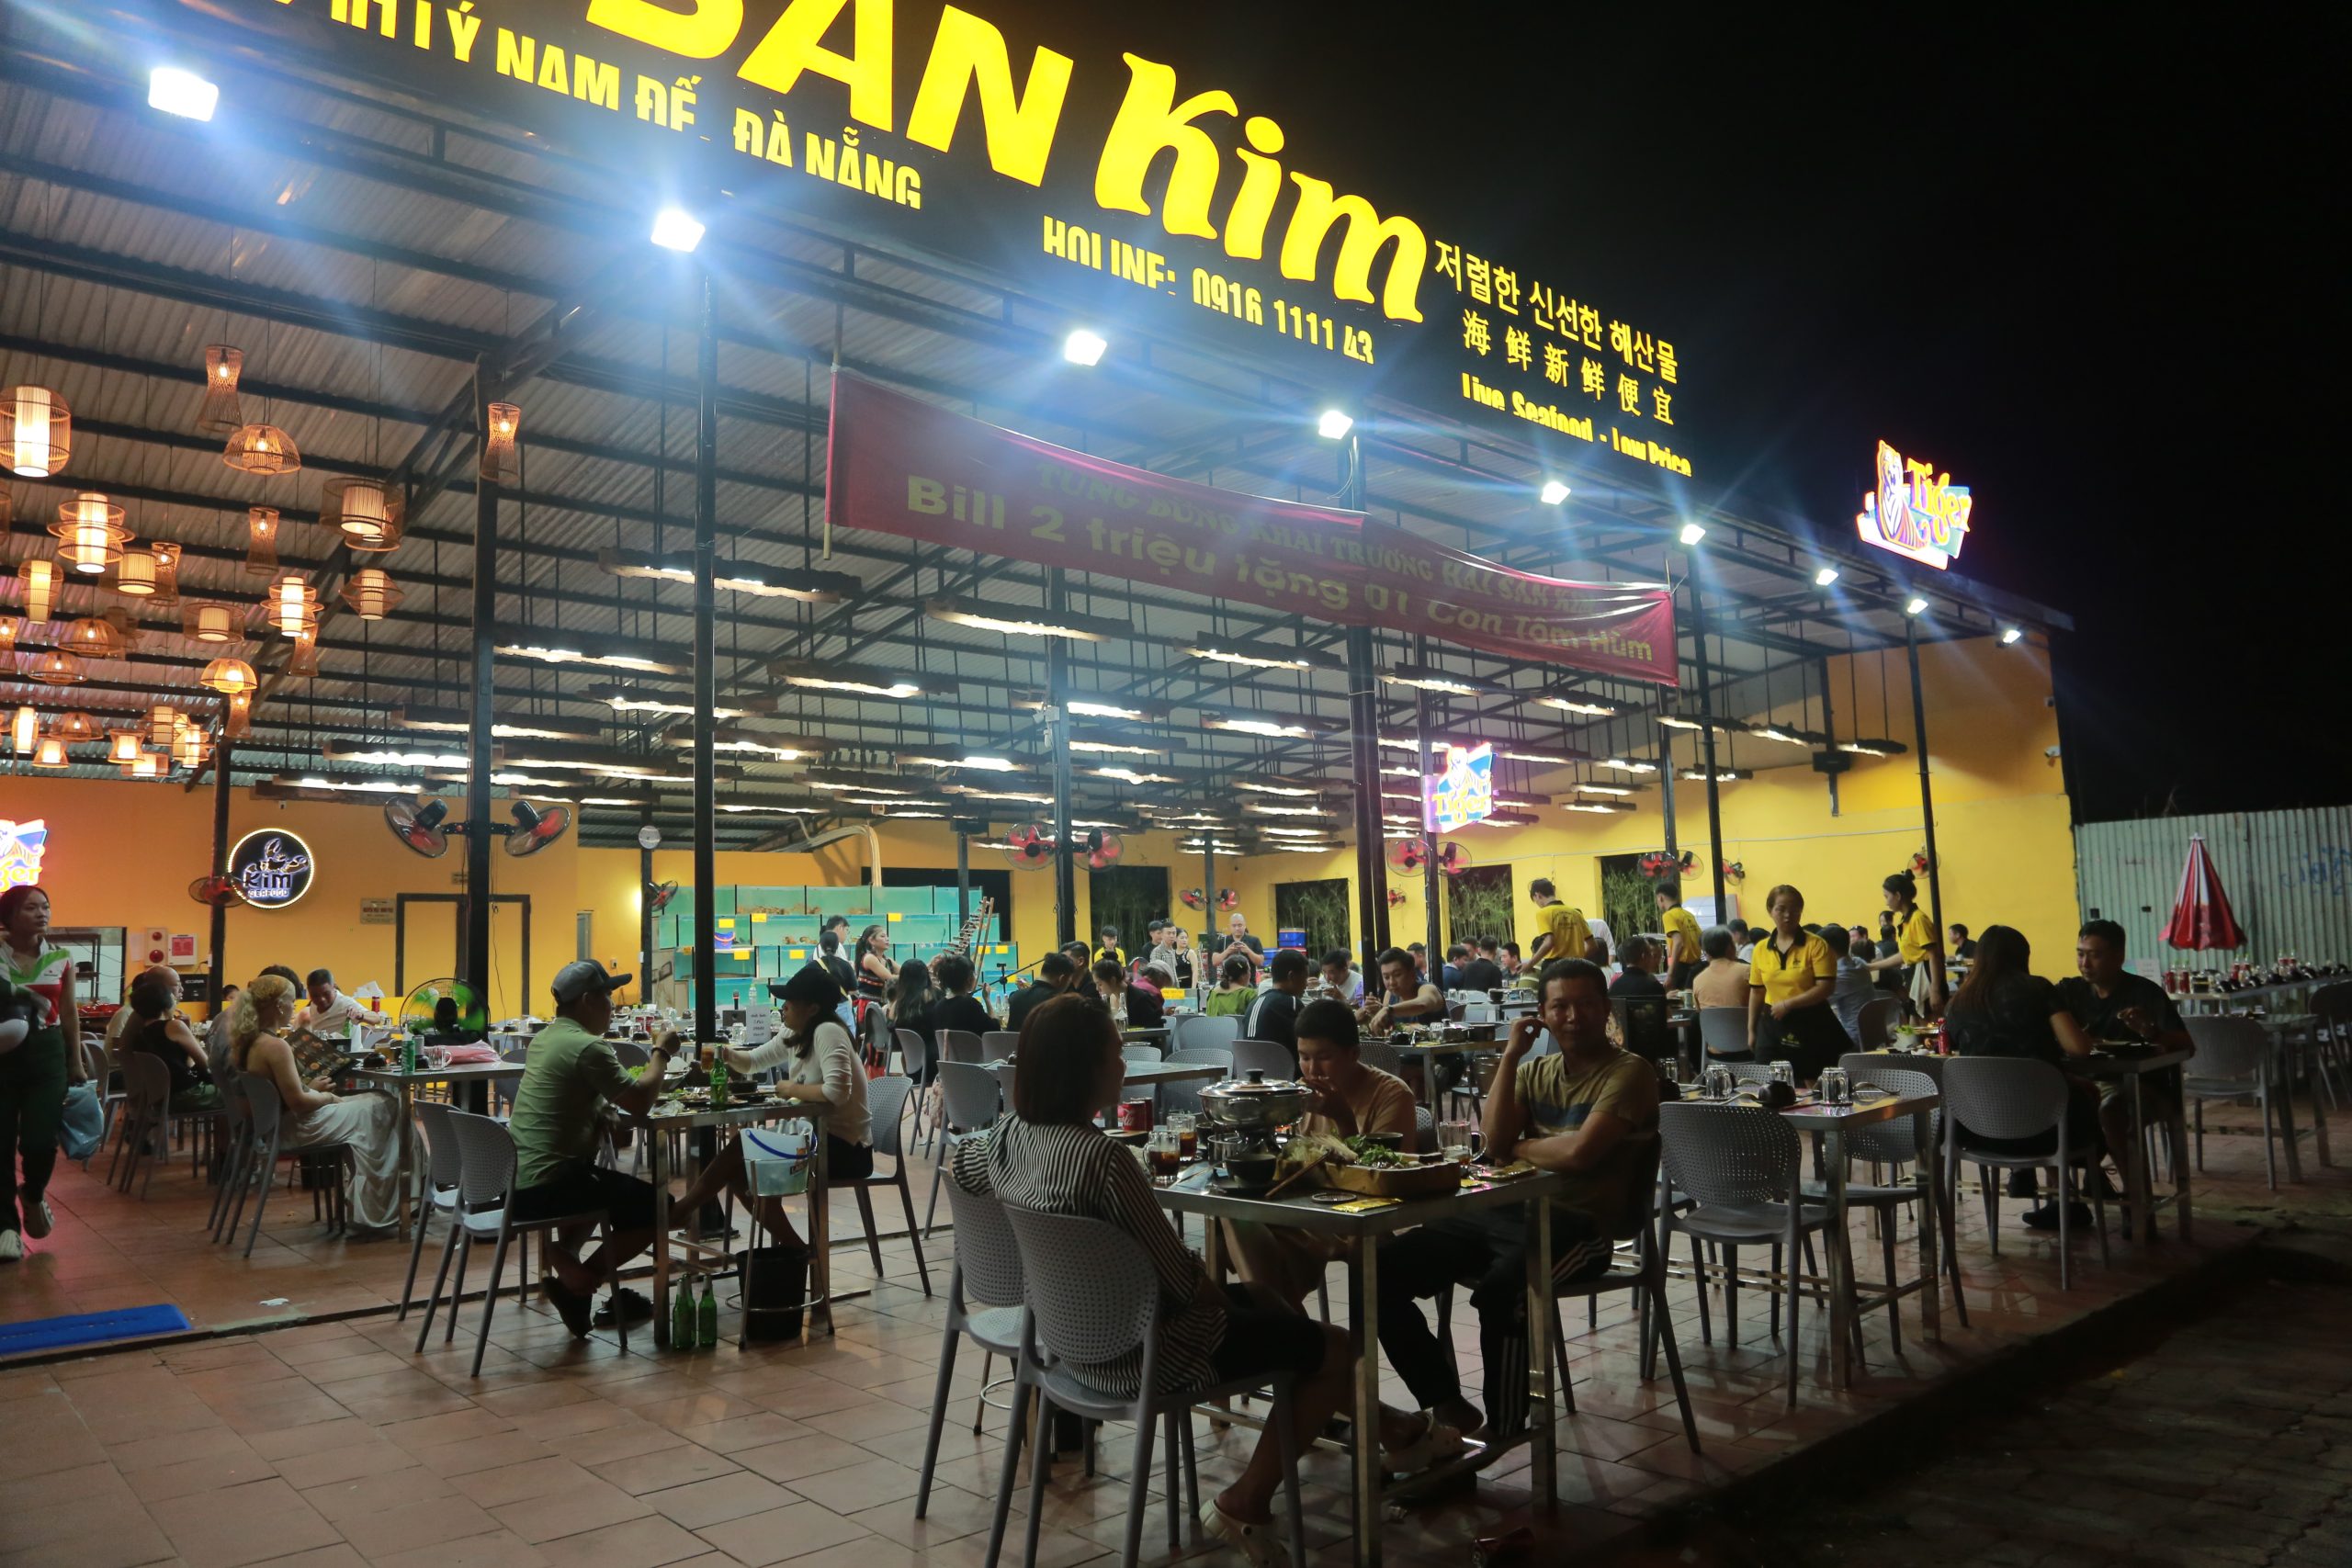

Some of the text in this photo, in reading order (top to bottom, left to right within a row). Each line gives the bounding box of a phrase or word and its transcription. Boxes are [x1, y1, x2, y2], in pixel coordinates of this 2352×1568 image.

[497, 28, 620, 111] NAM
[733, 107, 793, 167] ĐÀ
[805, 126, 921, 210] NẴNG
[1095, 52, 1427, 323] Kim
[1192, 267, 1263, 326] 0916
[1273, 299, 1334, 351] 1111
[1343, 324, 1374, 365] 43
[1434, 240, 1678, 384] 저렴한 신선한 해산물
[1511, 390, 1594, 443] Seafood
[1906, 457, 1973, 546] Tiger
[908, 475, 1006, 531] Bill
[1030, 506, 1066, 543] 2
[1085, 516, 1218, 576] triệu
[1426, 598, 1502, 636] Con
[1431, 788, 1490, 824] Tiger
[243, 863, 292, 889] Kim
